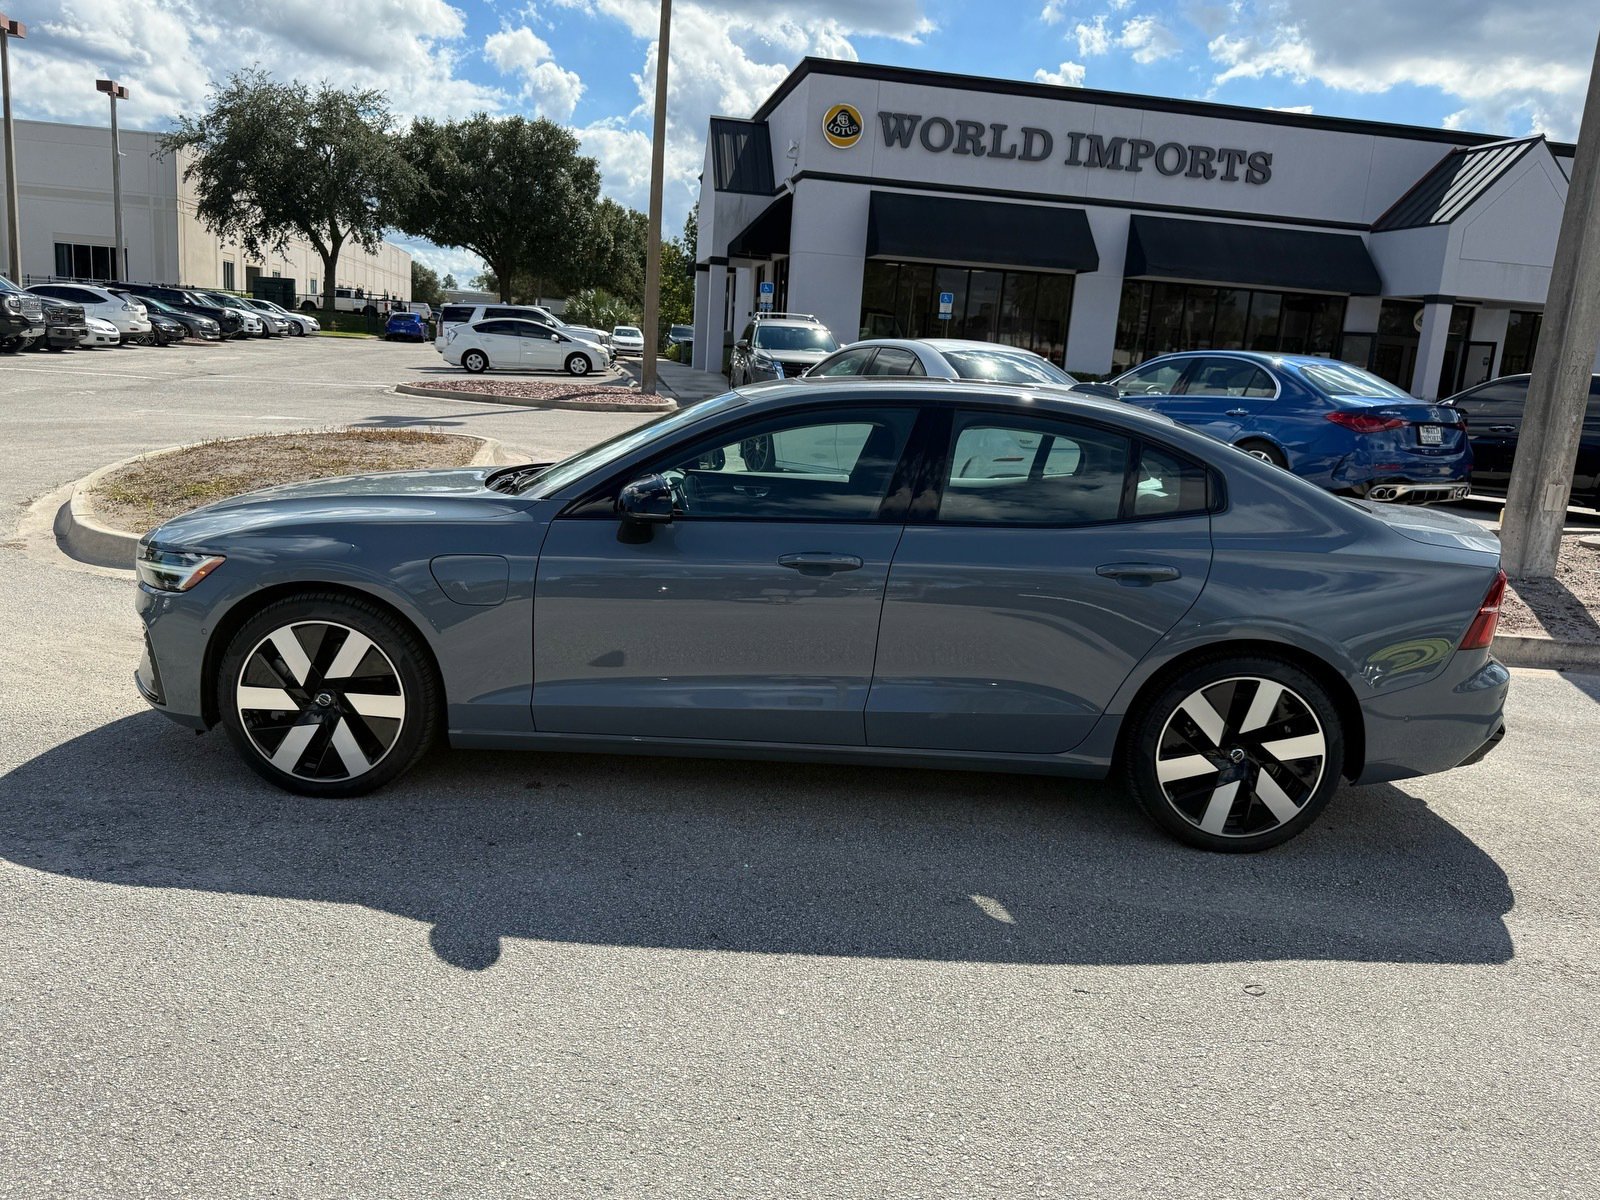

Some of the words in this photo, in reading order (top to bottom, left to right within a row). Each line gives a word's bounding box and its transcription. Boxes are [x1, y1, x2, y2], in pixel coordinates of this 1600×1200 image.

[828, 123, 859, 135] LOTUS
[878, 111, 1054, 162] WORLD
[1064, 131, 1274, 185] IMPORTS
